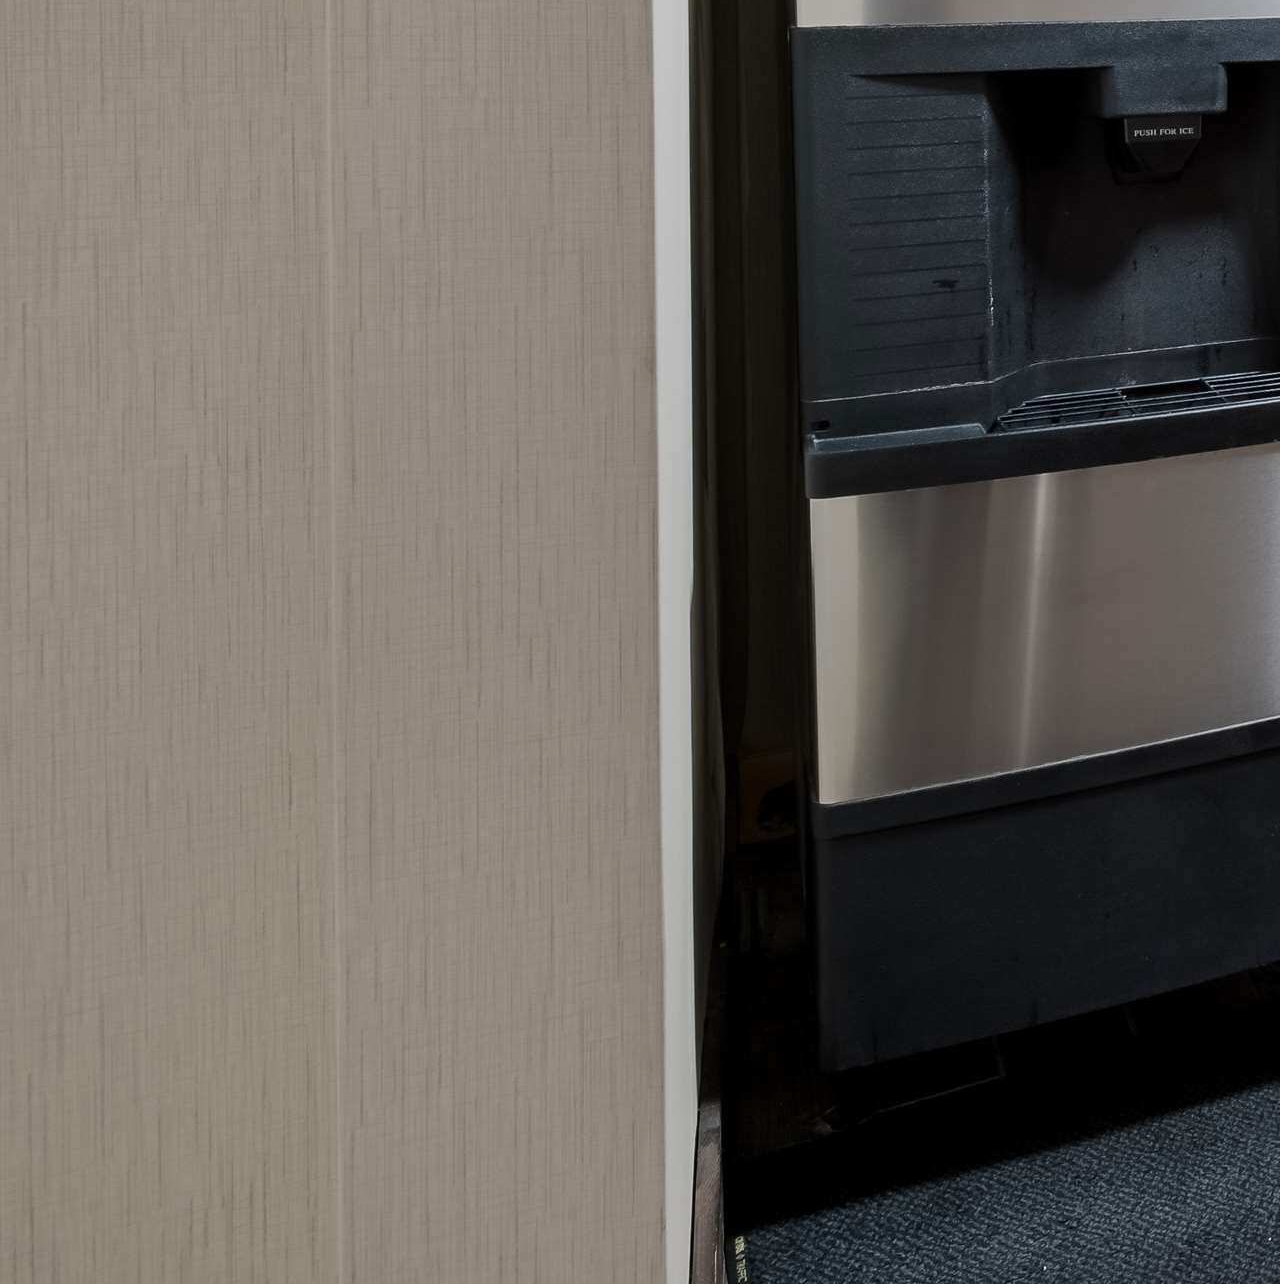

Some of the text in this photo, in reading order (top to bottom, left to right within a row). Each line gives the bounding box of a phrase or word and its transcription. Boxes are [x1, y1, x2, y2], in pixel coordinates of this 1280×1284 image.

[1134, 127, 1194, 137] PUSH FOR ICE
